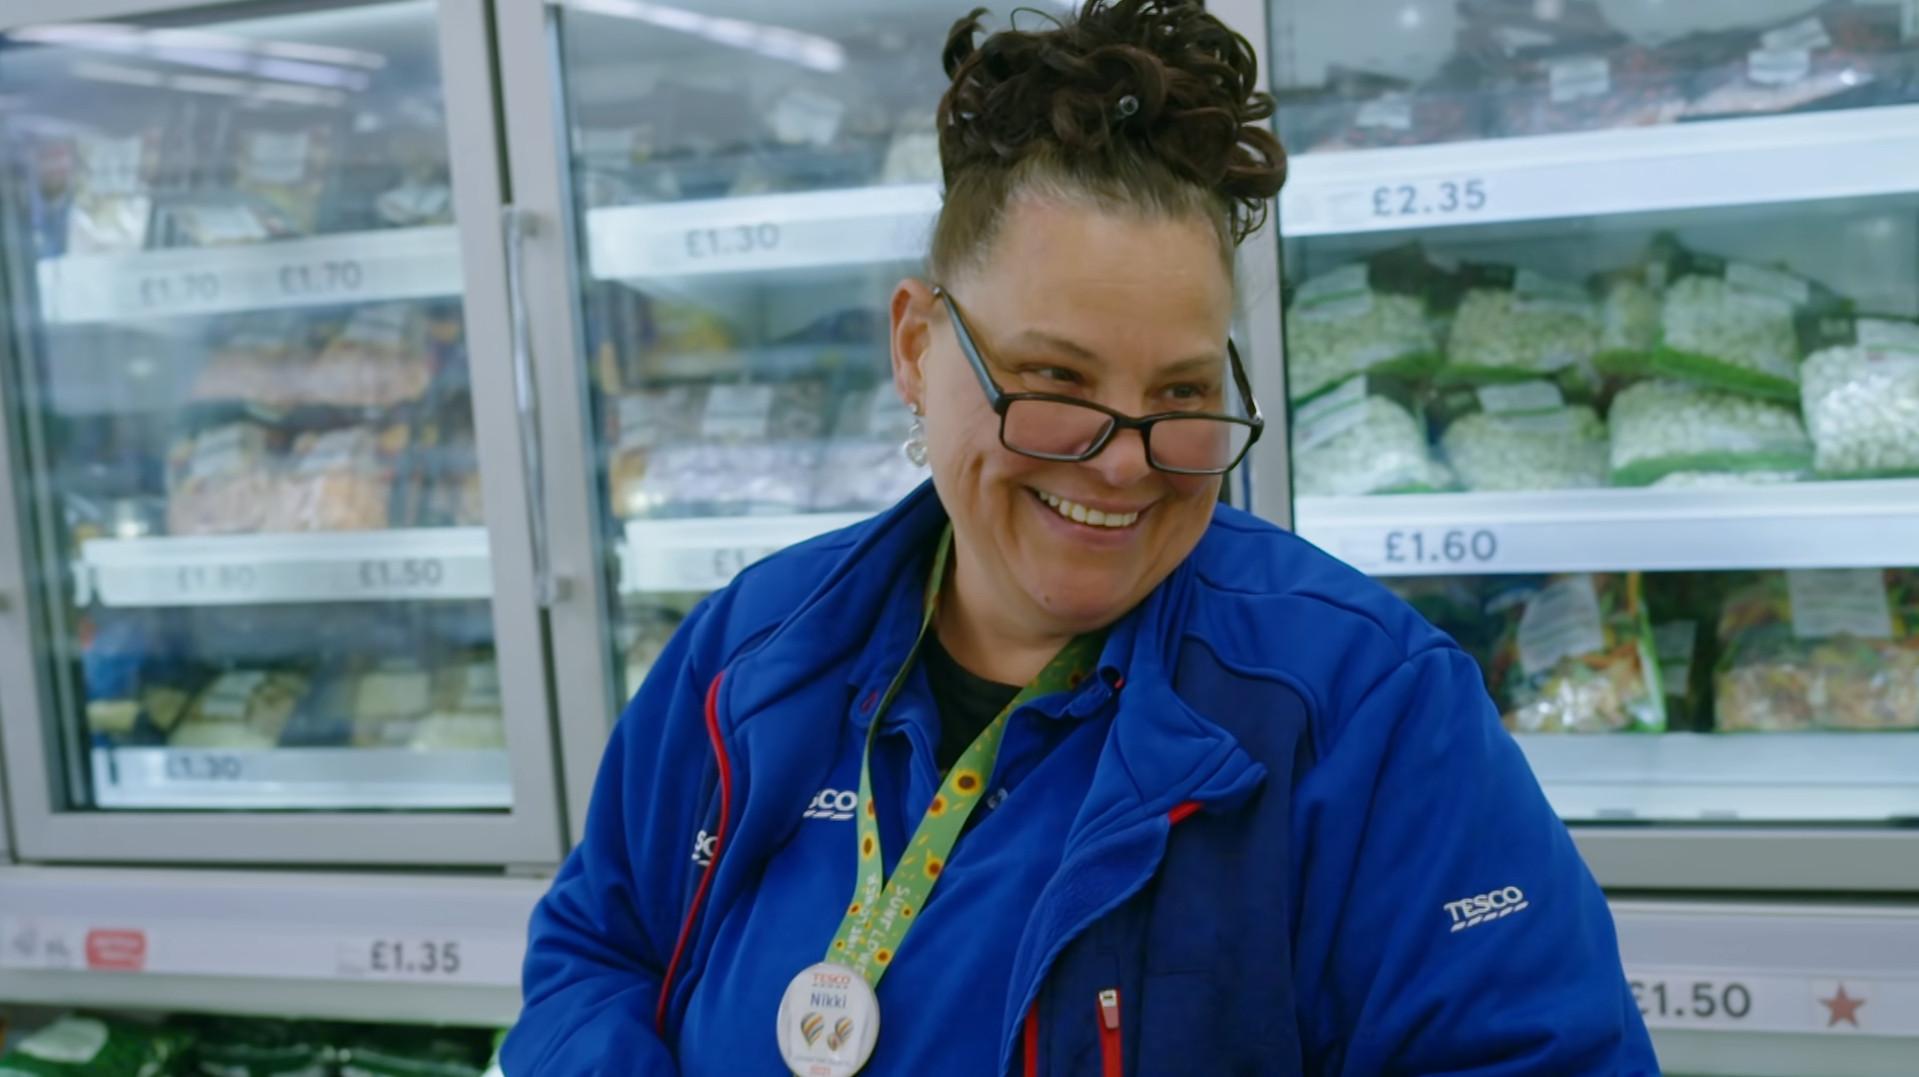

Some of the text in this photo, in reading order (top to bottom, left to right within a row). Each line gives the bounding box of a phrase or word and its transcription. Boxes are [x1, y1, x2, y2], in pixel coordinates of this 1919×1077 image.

[1372, 178, 1487, 216] £2.35
[684, 221, 781, 259] £1.30
[278, 259, 363, 295] £1.70
[1385, 529, 1498, 562] £1.60
[358, 557, 444, 588] £1.50
[1443, 886, 1524, 922] TESCO
[370, 940, 461, 974] £1.35
[813, 973, 850, 985] TESCO
[809, 992, 848, 1009] Nikki
